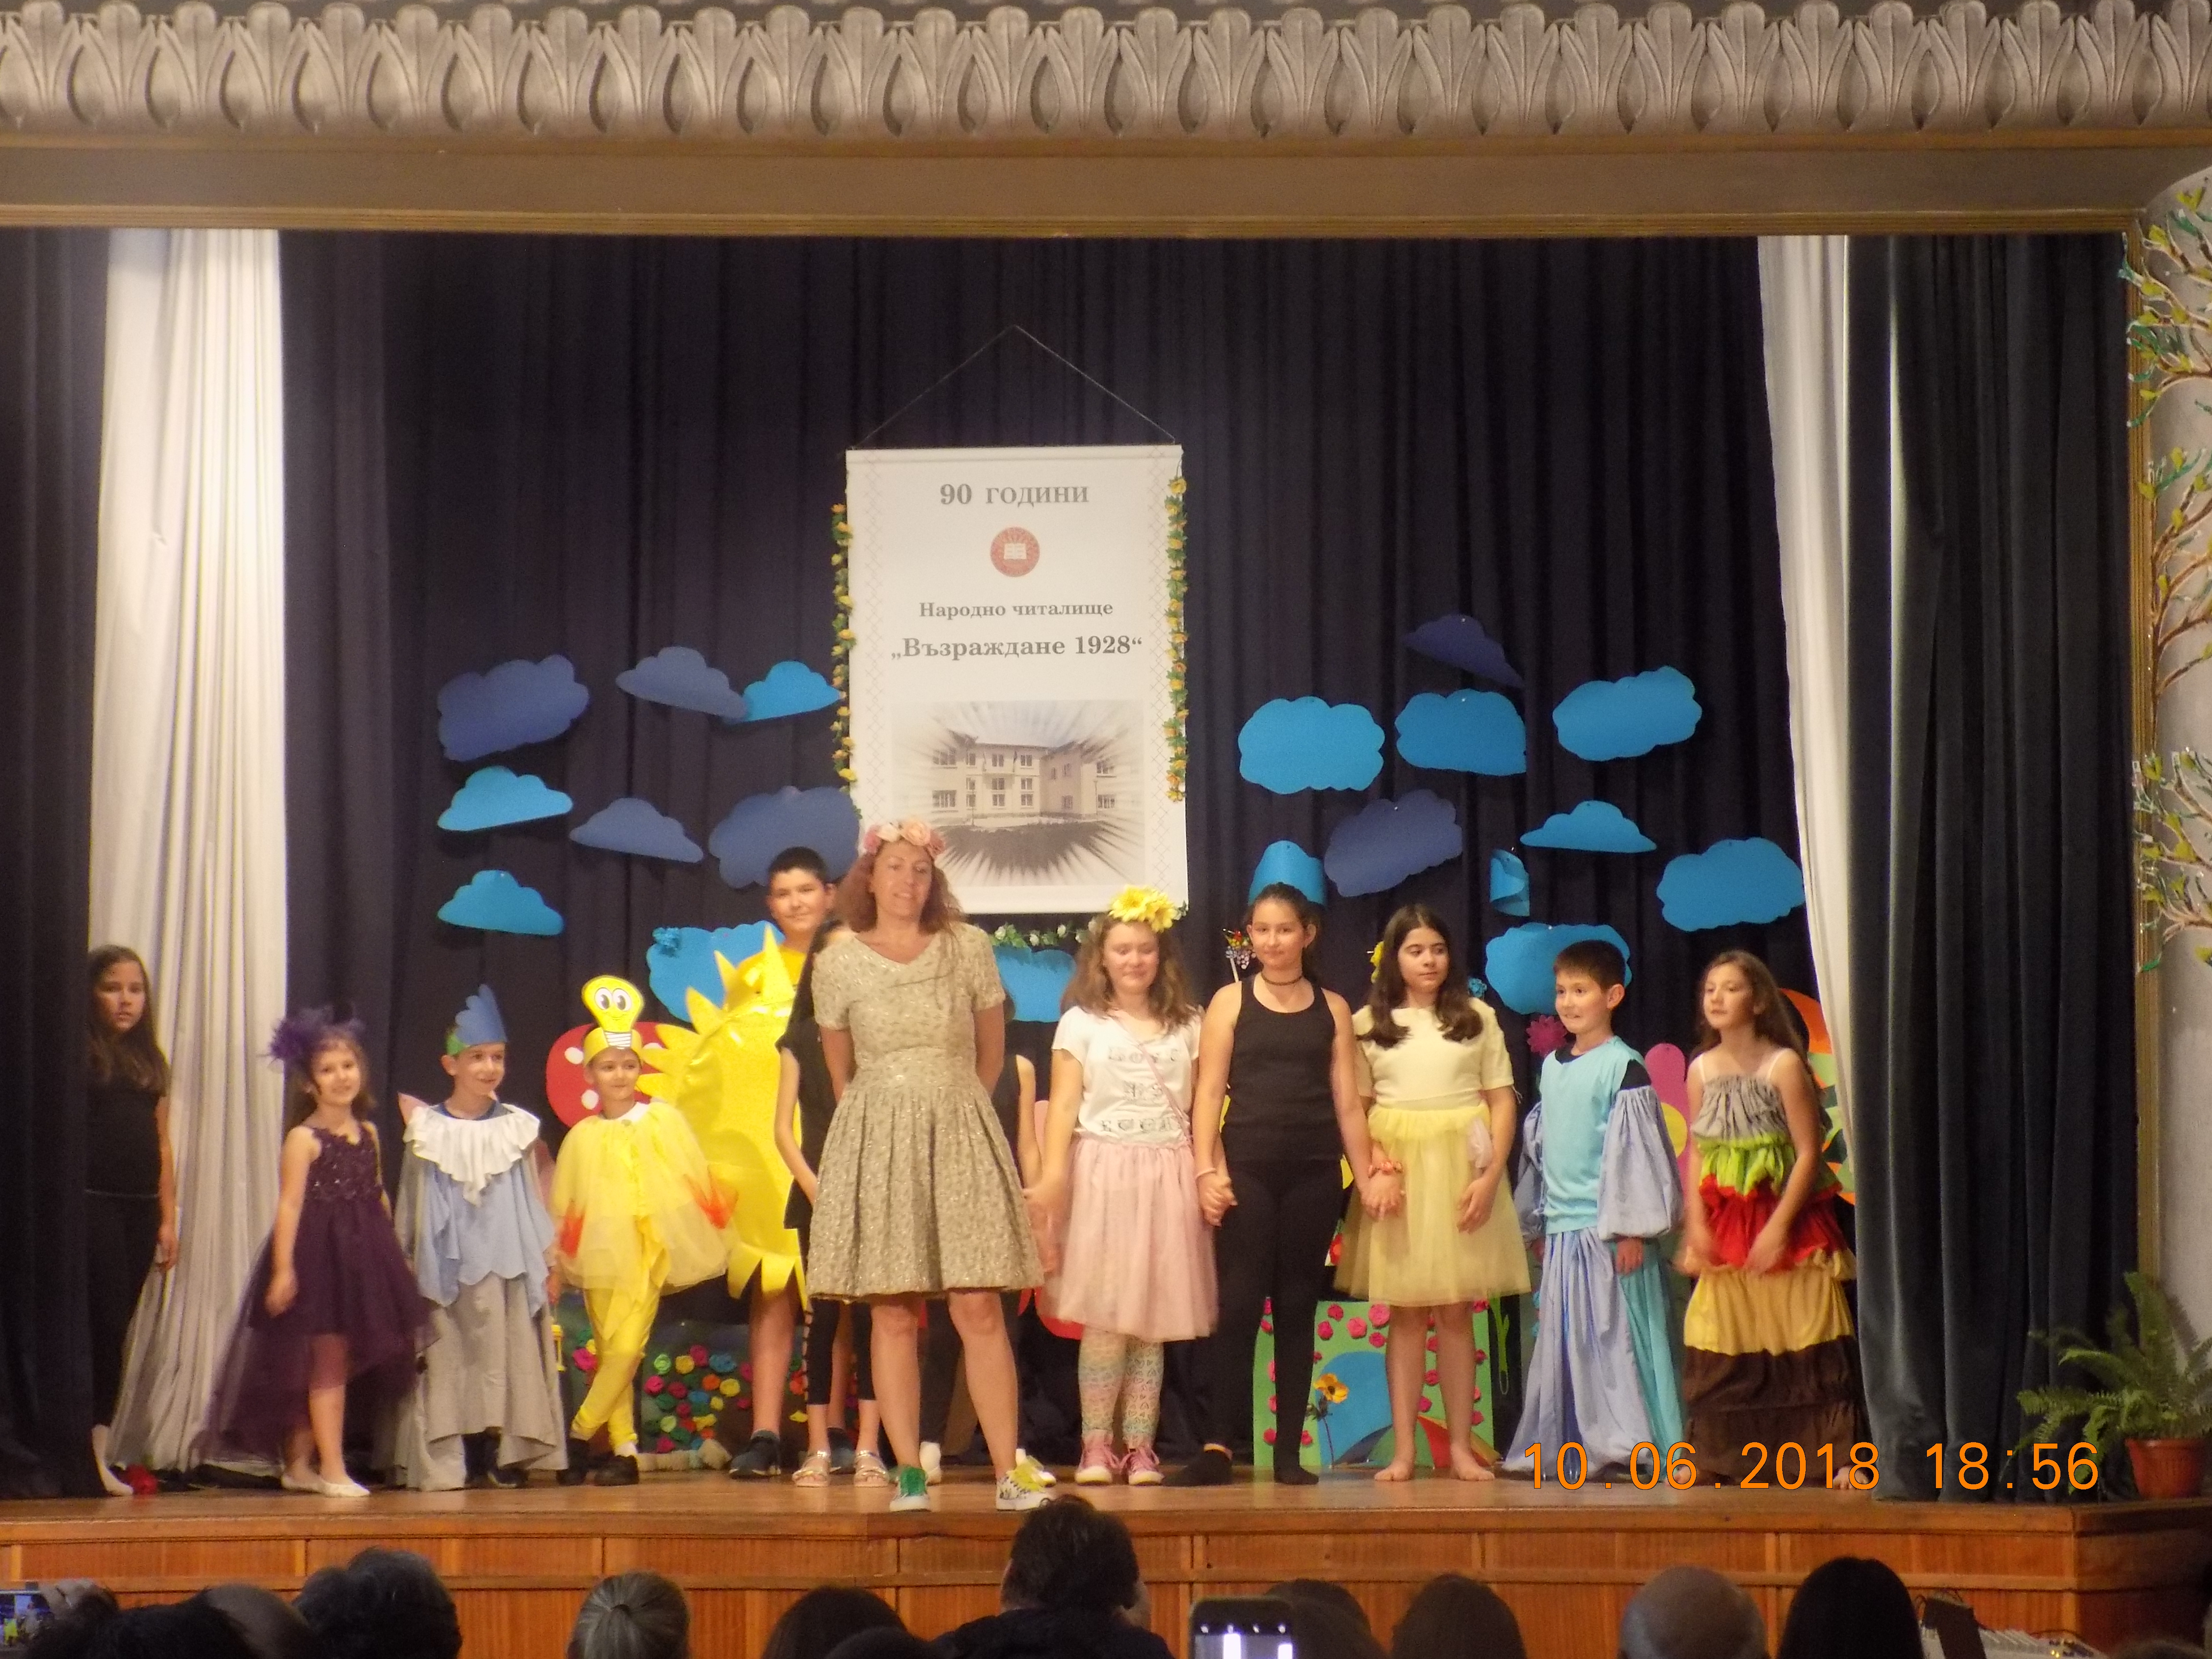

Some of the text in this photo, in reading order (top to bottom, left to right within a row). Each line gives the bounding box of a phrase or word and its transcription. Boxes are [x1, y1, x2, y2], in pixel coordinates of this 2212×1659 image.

[940, 483, 1089, 507] 90 години
[920, 602, 1114, 621] Народно читалище
[891, 635, 1143, 662] „Възраждане 1928“
